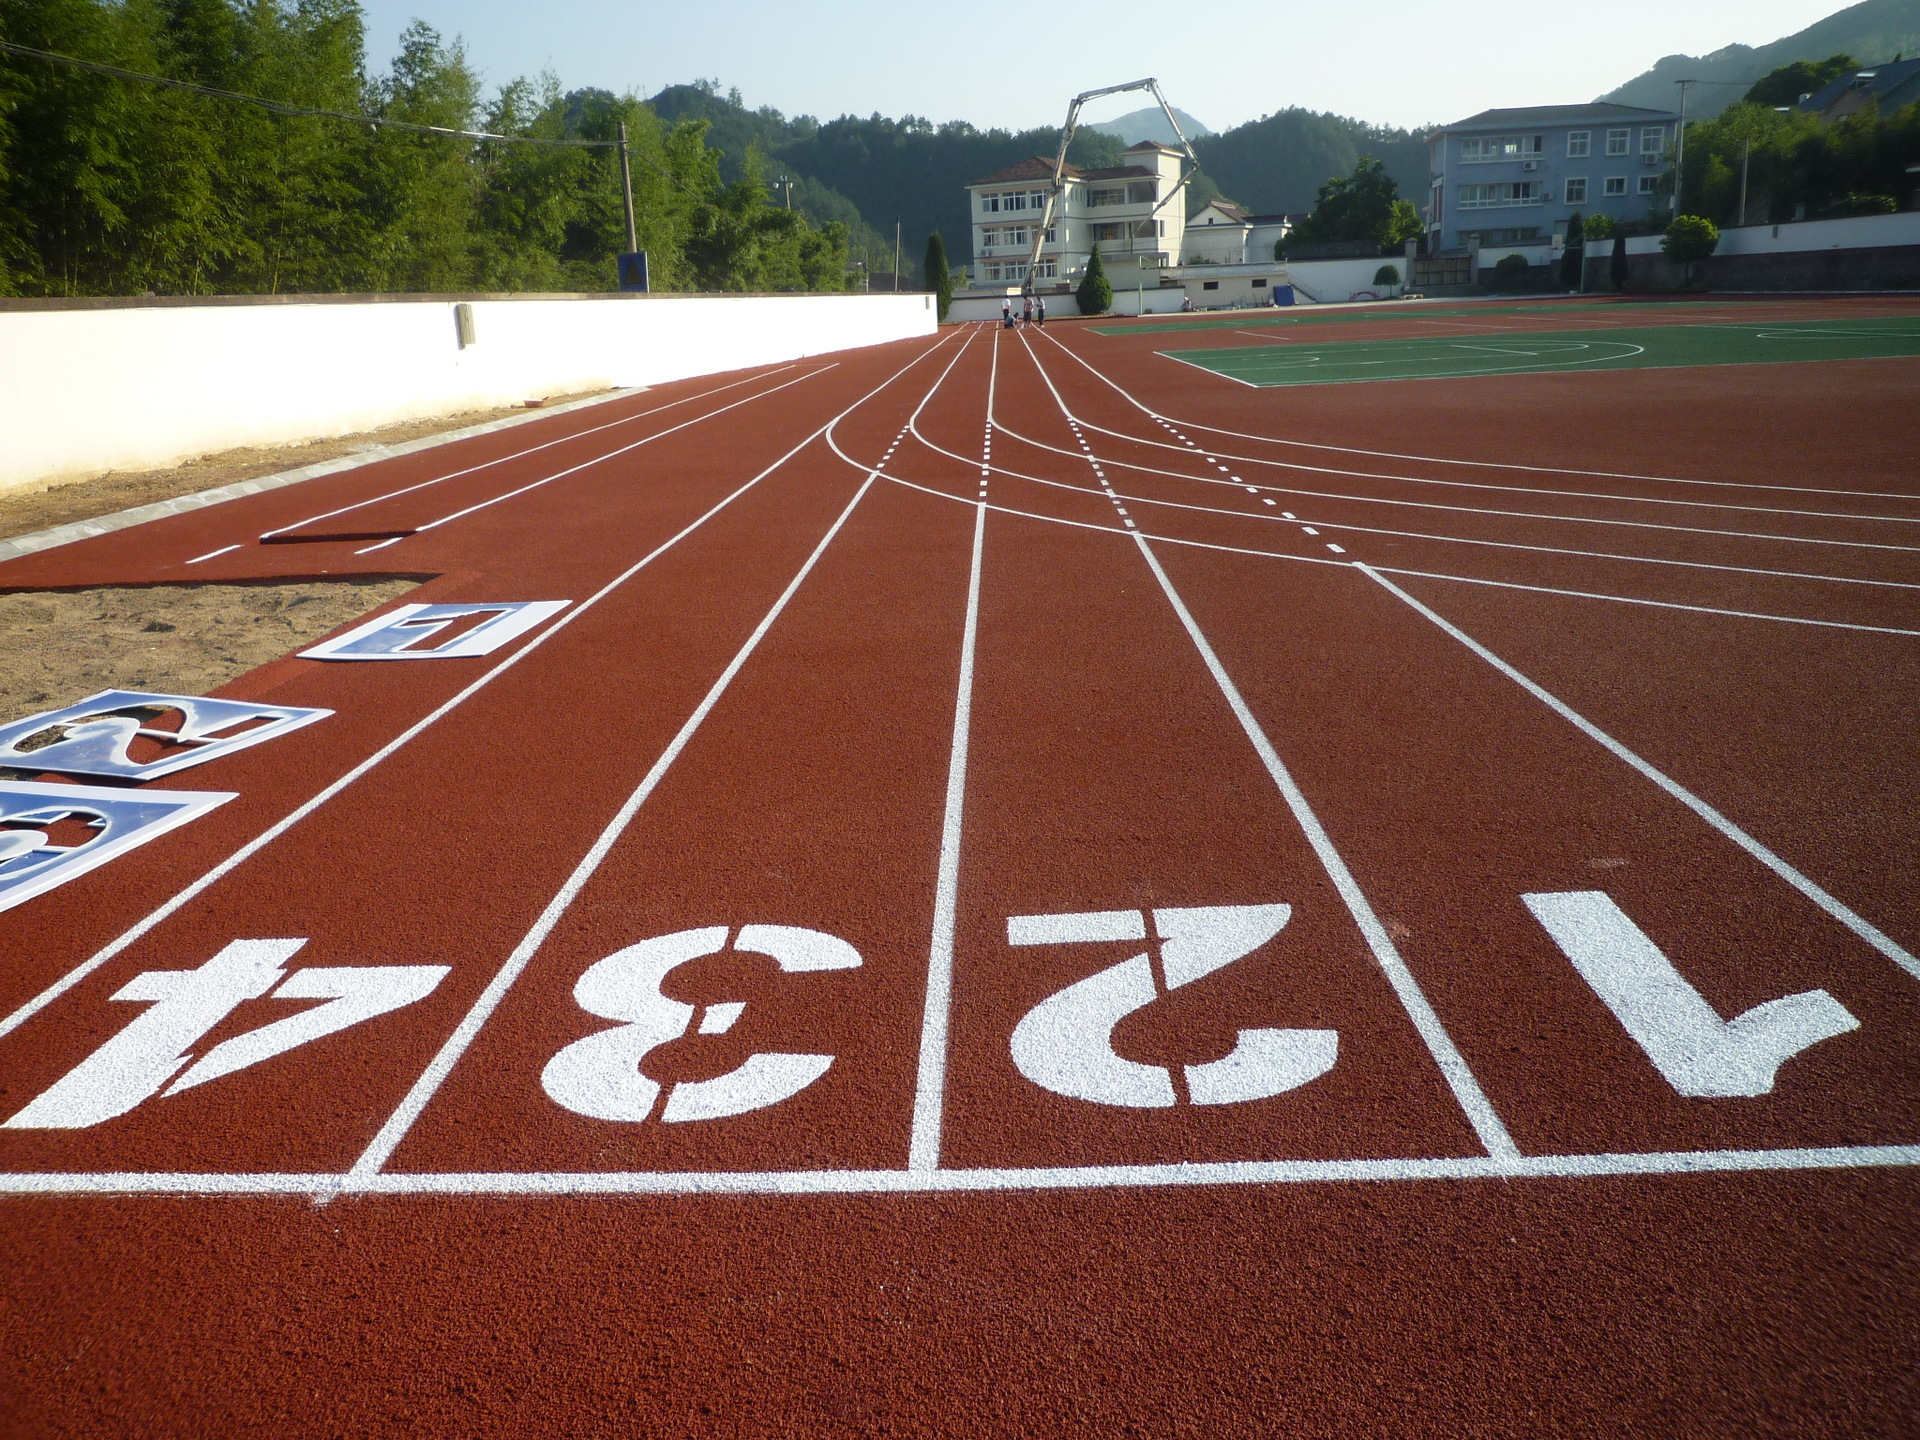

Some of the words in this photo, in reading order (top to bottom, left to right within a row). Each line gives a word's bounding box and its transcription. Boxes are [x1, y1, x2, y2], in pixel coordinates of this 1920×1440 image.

[0, 937, 452, 1130] 4
[540, 923, 865, 1125] 3
[1007, 903, 1340, 1109] 2
[1520, 890, 1861, 1098] 1
